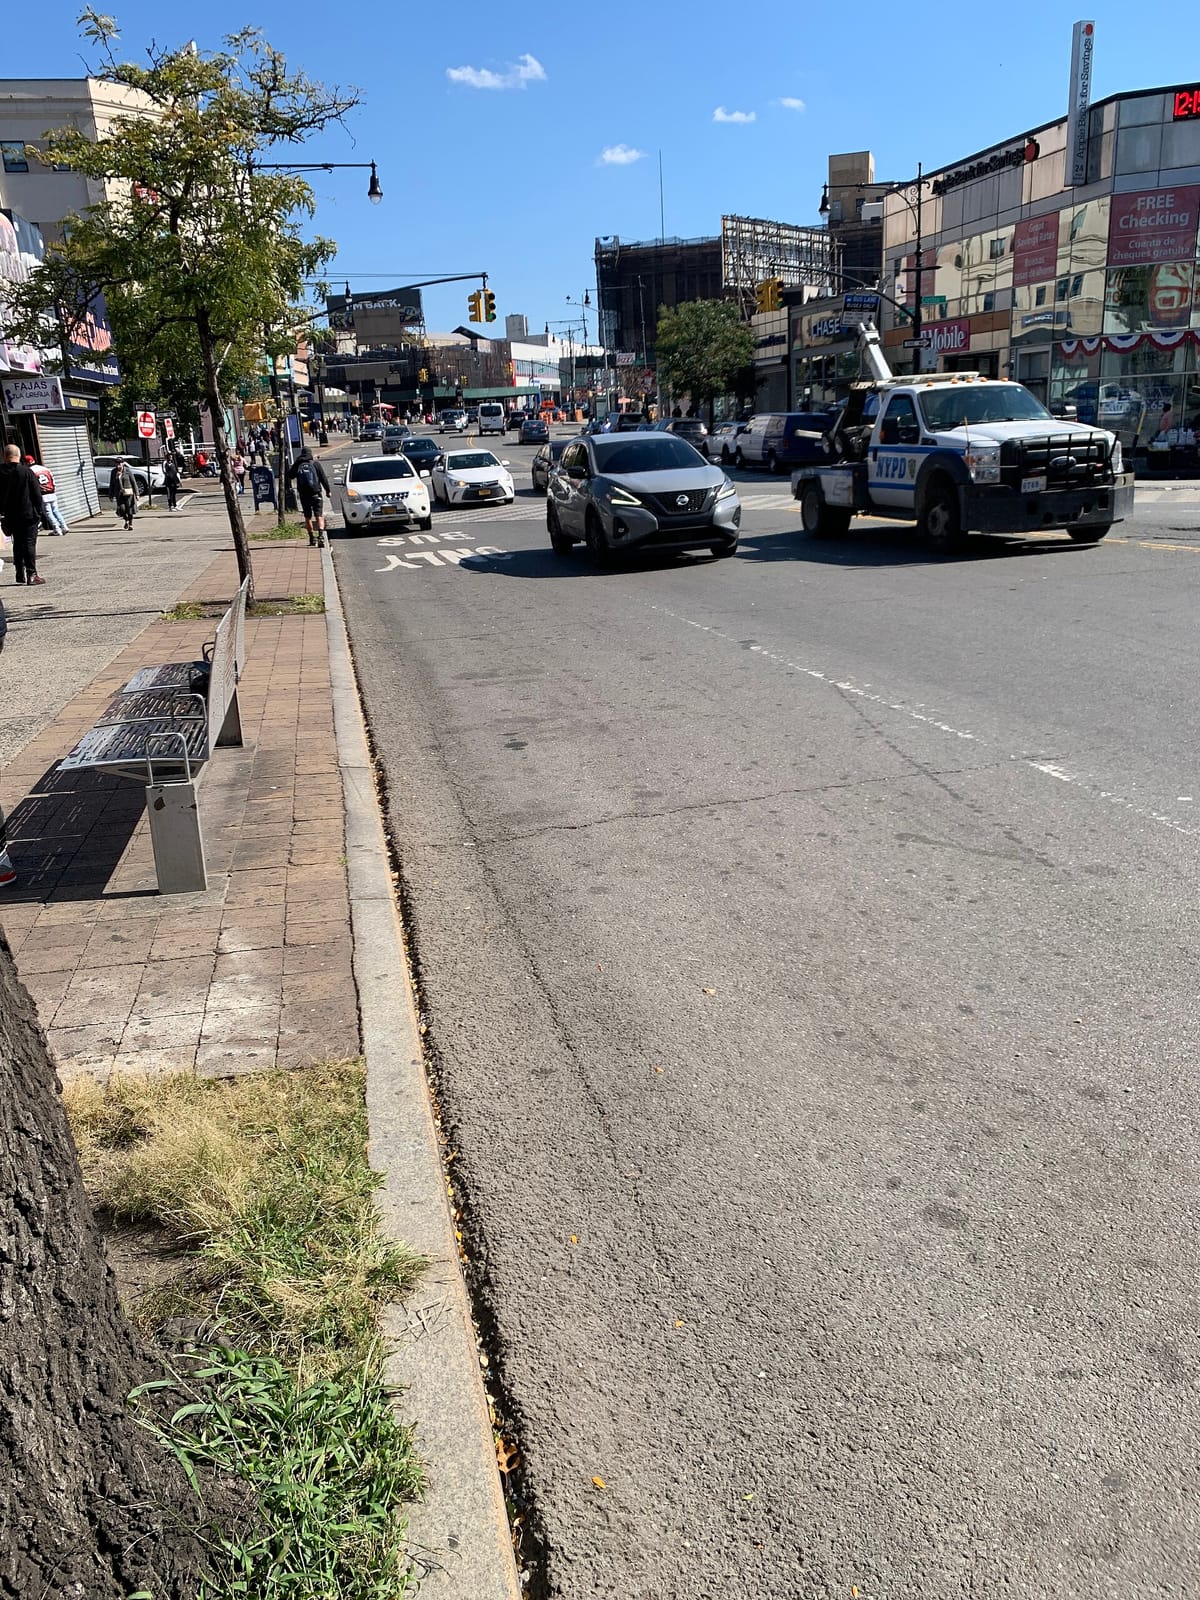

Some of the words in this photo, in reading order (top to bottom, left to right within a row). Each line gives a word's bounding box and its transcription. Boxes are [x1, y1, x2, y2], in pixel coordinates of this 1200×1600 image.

[1081, 38, 1093, 80] Savings
[1080, 81, 1089, 98] for
[1078, 100, 1087, 128] Bank
[1137, 194, 1175, 211] FREE
[1119, 210, 1190, 229] Checking
[1129, 239, 1161, 249] Cuenta
[1163, 236, 1176, 245] de
[811, 318, 841, 337] CHASE
[14, 381, 48, 391] FAJAS
[876, 456, 907, 479] NYPD
[376, 530, 477, 547] BUS
[373, 545, 513, 573] ONLY
